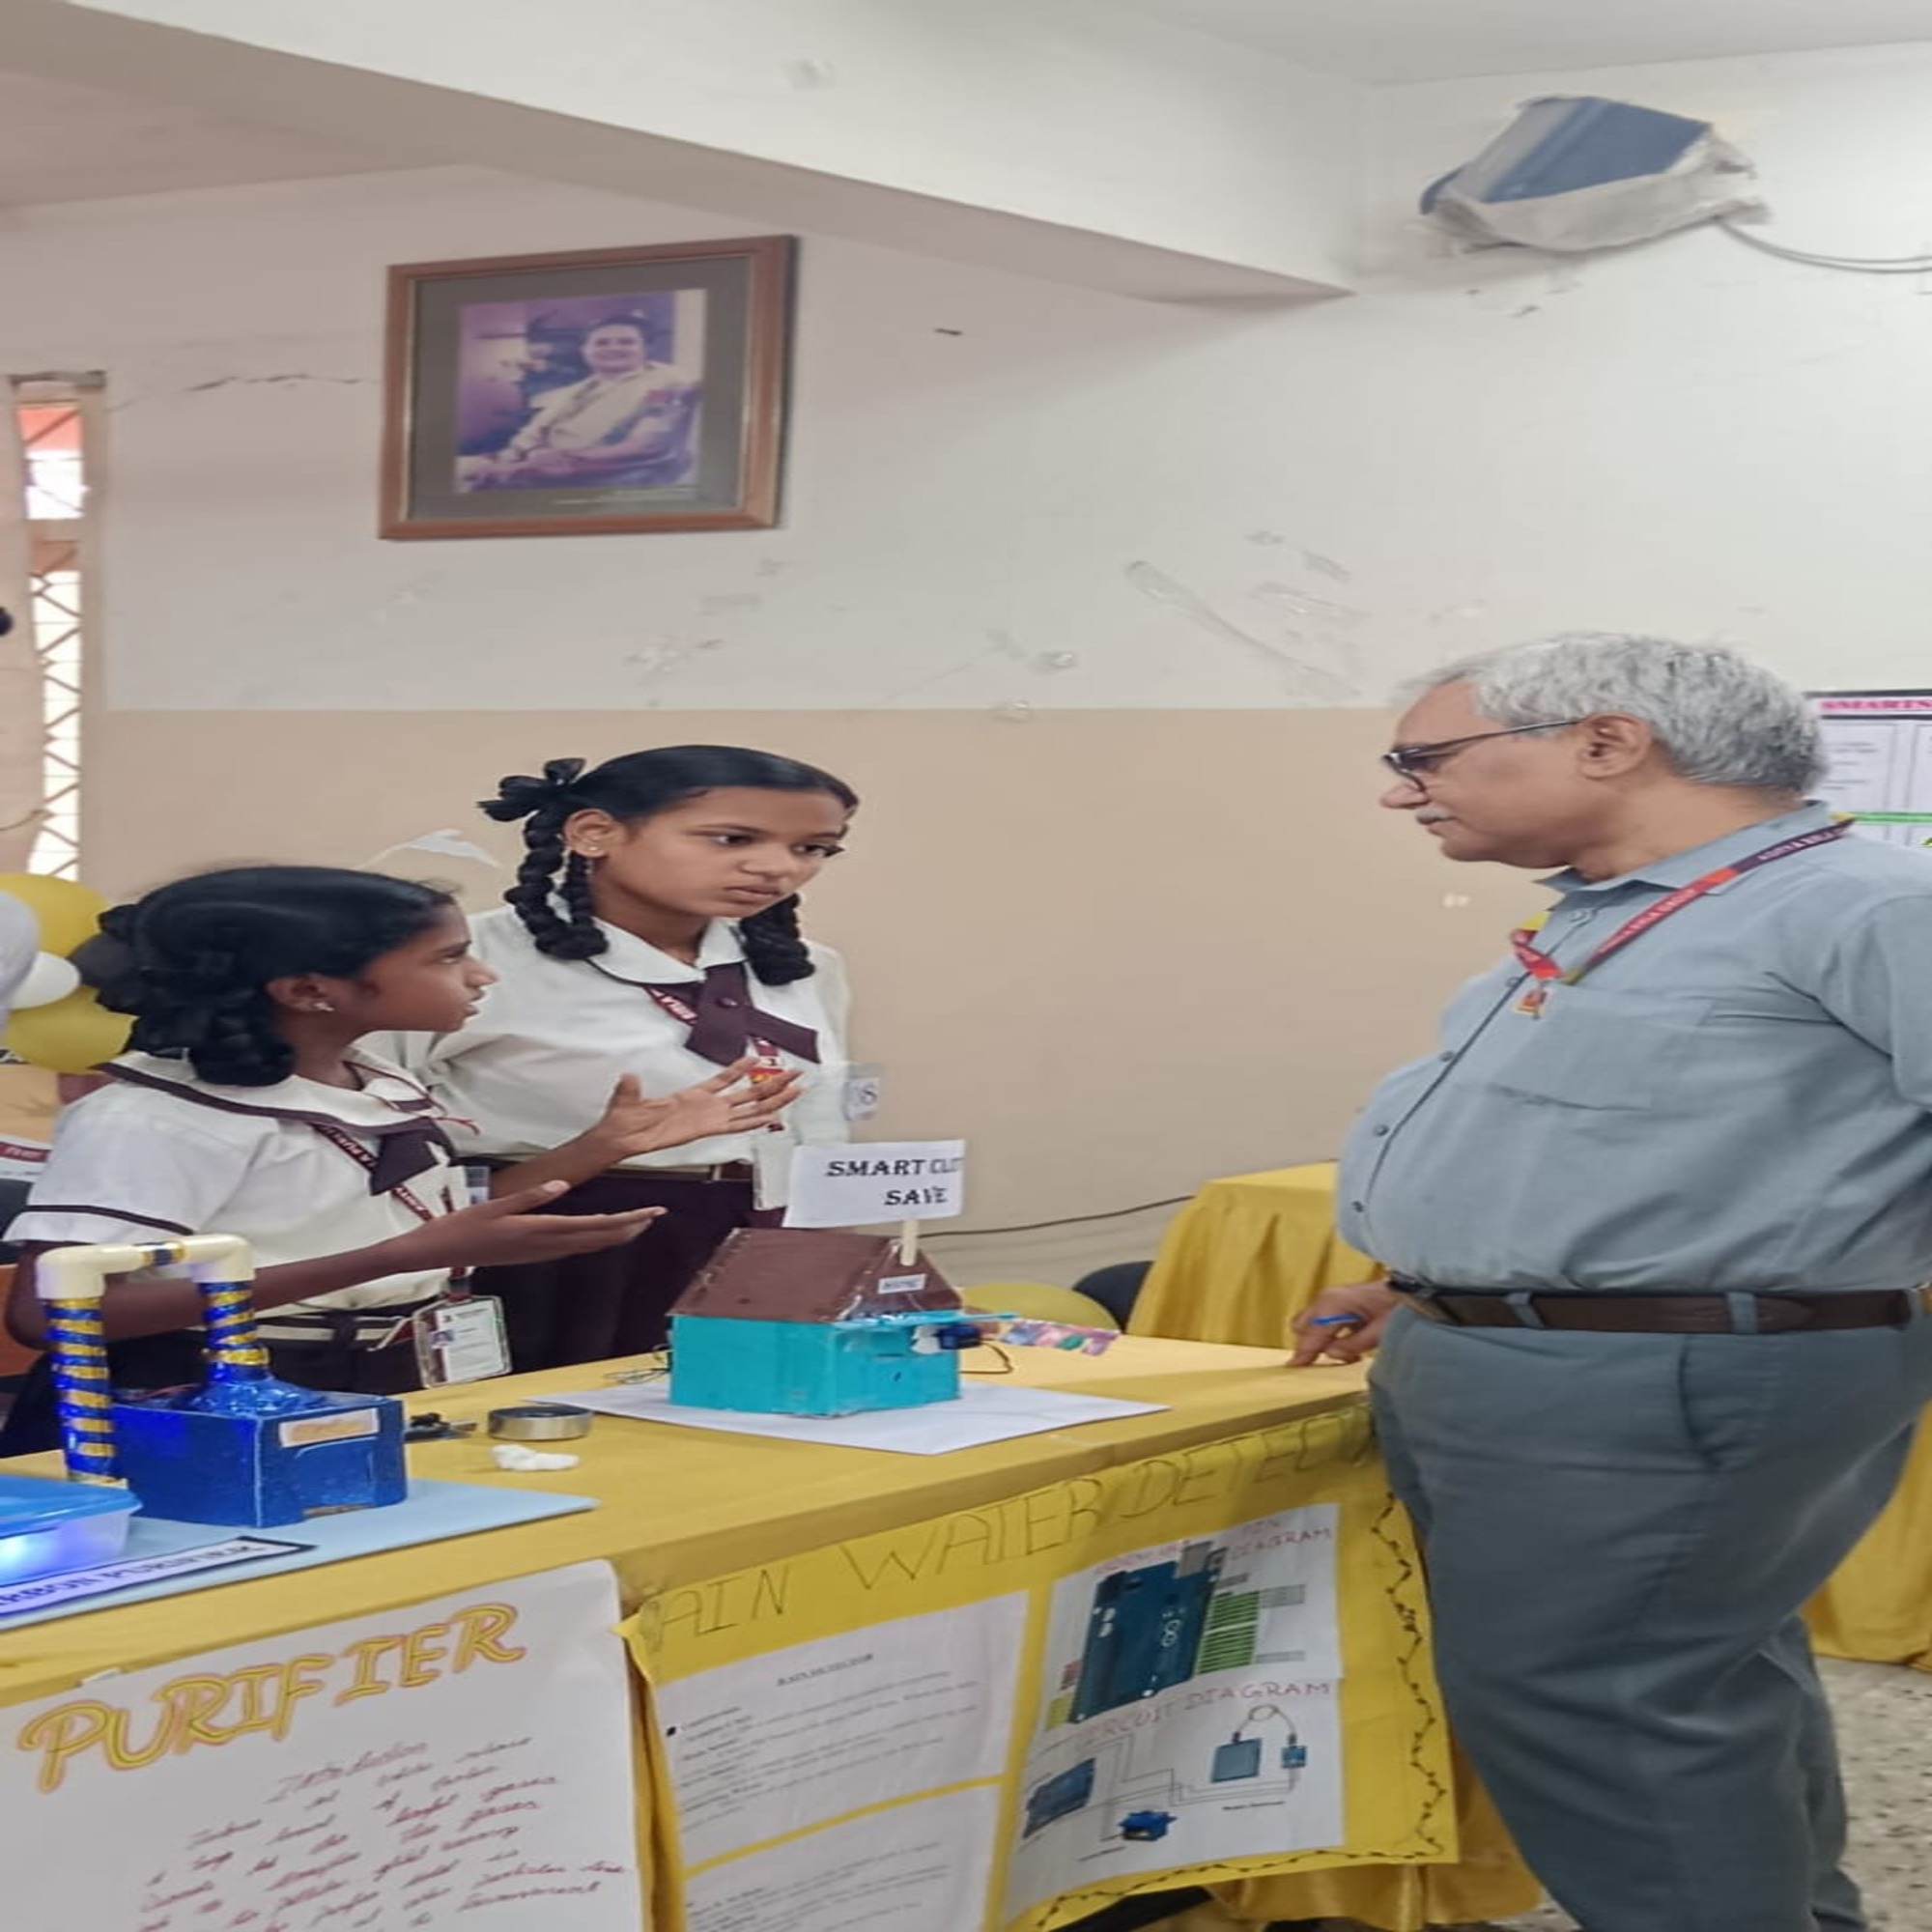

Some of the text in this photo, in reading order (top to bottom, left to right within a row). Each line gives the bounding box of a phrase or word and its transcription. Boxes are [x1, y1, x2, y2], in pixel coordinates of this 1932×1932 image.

[826, 1158, 926, 1178] SMART
[837, 1477, 1107, 1590] WATER
[15, 1602, 527, 1794] PURIFIER
[1182, 1680, 1332, 1711] DIAGRAM
